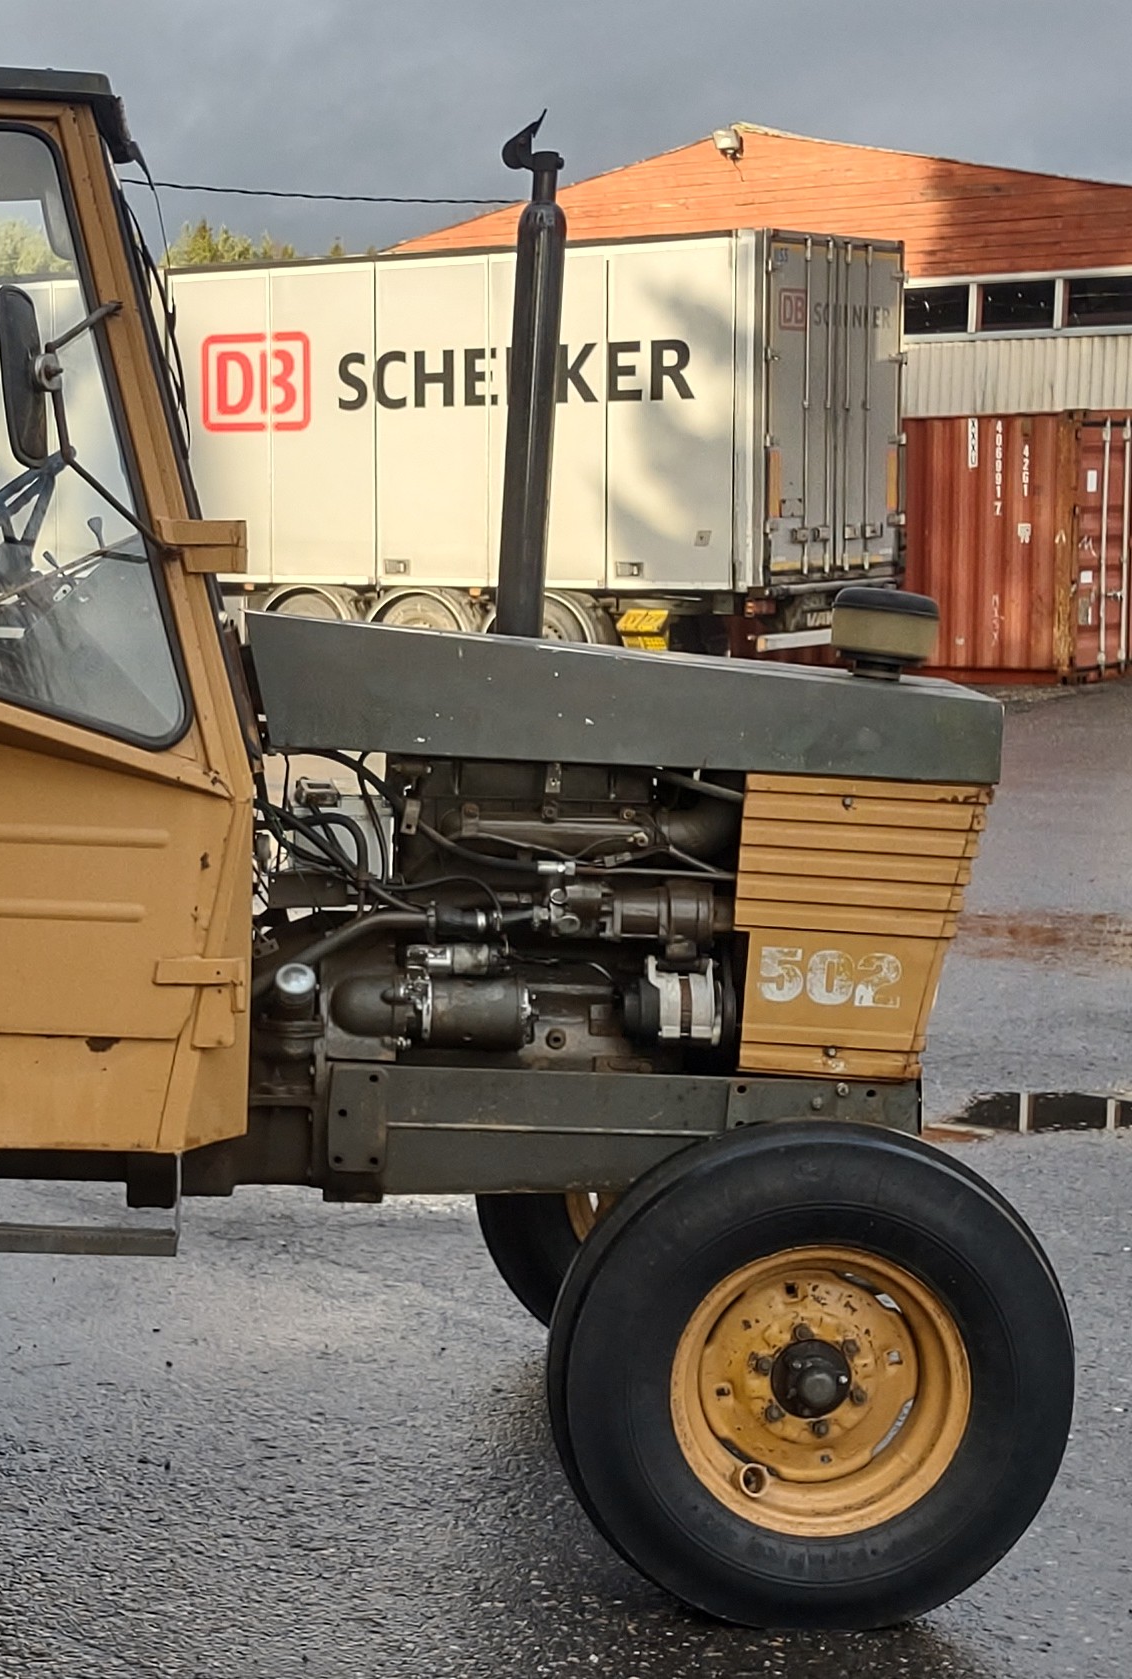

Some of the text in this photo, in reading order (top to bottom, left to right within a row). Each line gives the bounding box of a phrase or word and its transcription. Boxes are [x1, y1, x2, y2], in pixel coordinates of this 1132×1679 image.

[782, 293, 806, 326] DB
[213, 339, 696, 419] DB SCHEKER
[1022, 444, 1030, 497] 42G1
[758, 946, 903, 1009] 502
